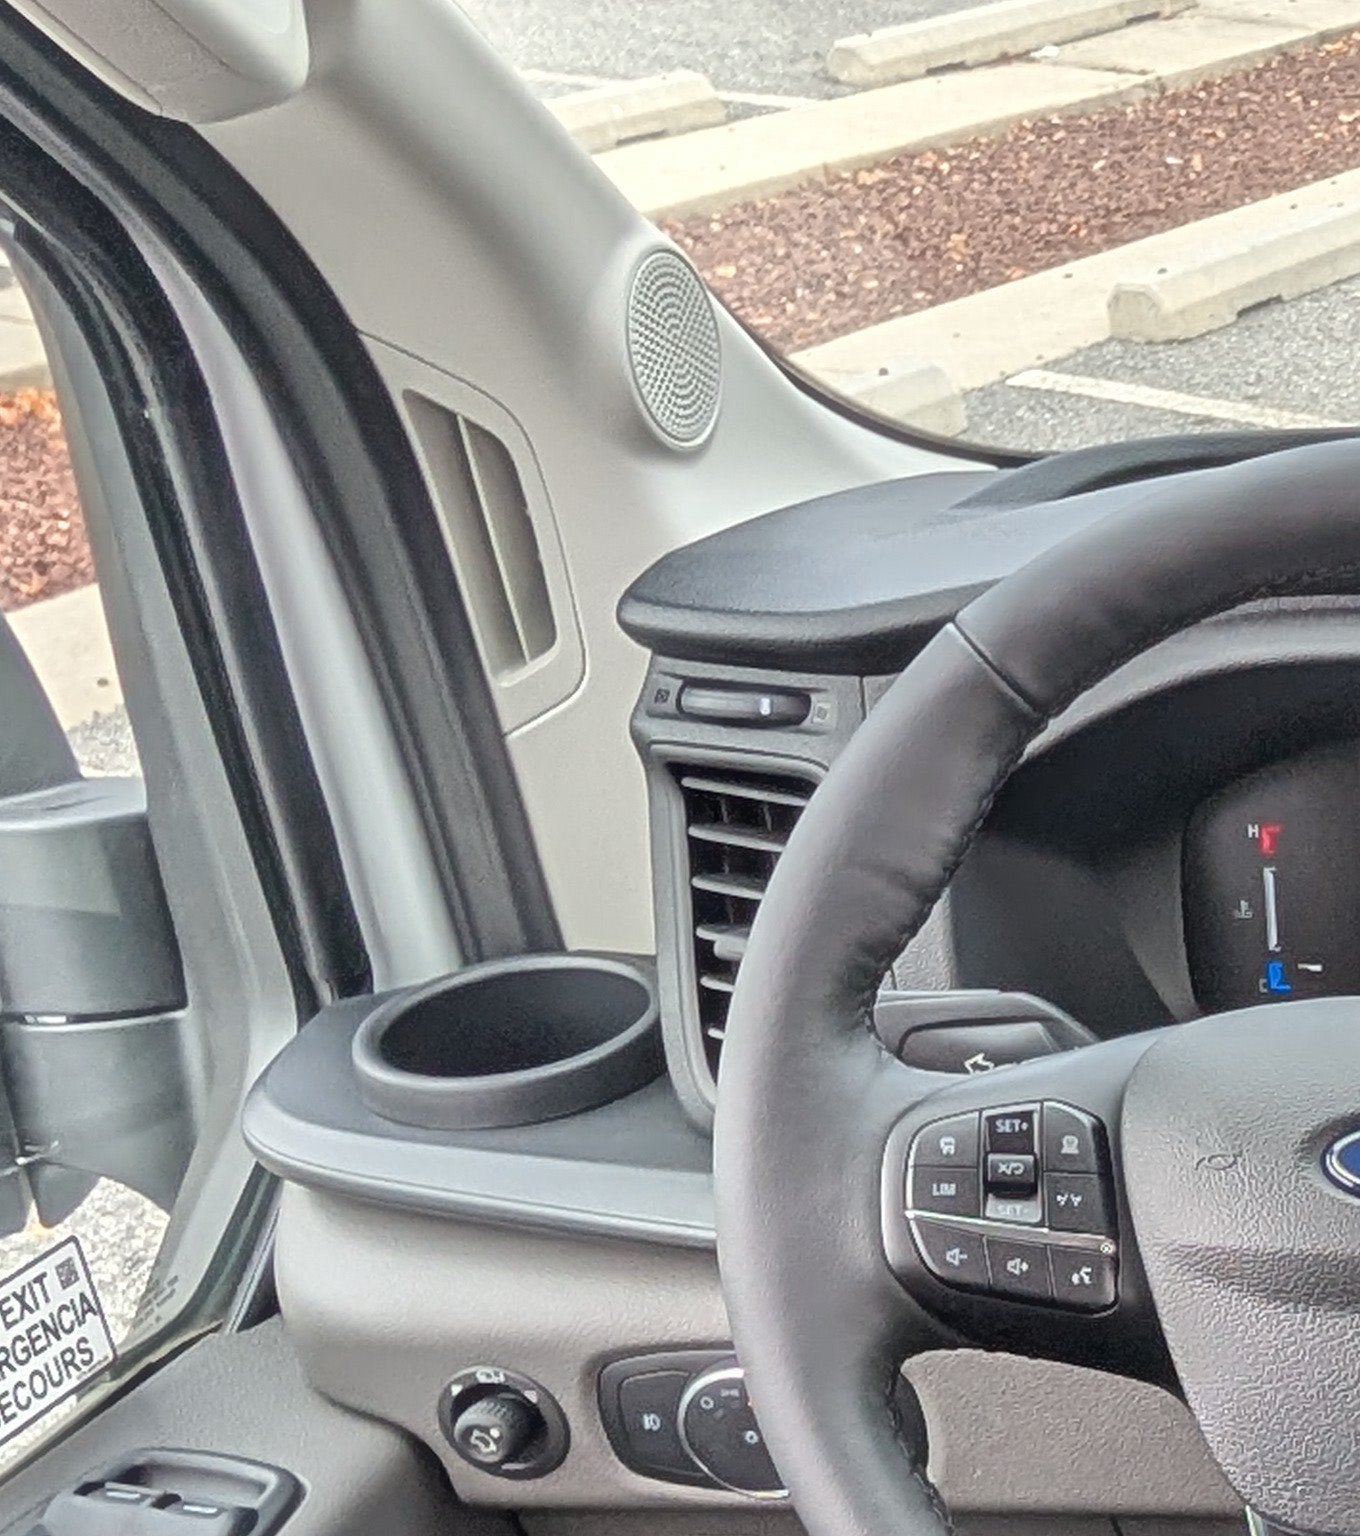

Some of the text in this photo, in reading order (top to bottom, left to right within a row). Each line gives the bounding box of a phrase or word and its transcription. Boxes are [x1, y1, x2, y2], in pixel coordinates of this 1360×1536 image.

[1247, 823, 1259, 838] H
[1, 1272, 50, 1330] EXIT
[0, 1336, 94, 1425] ECOURS
